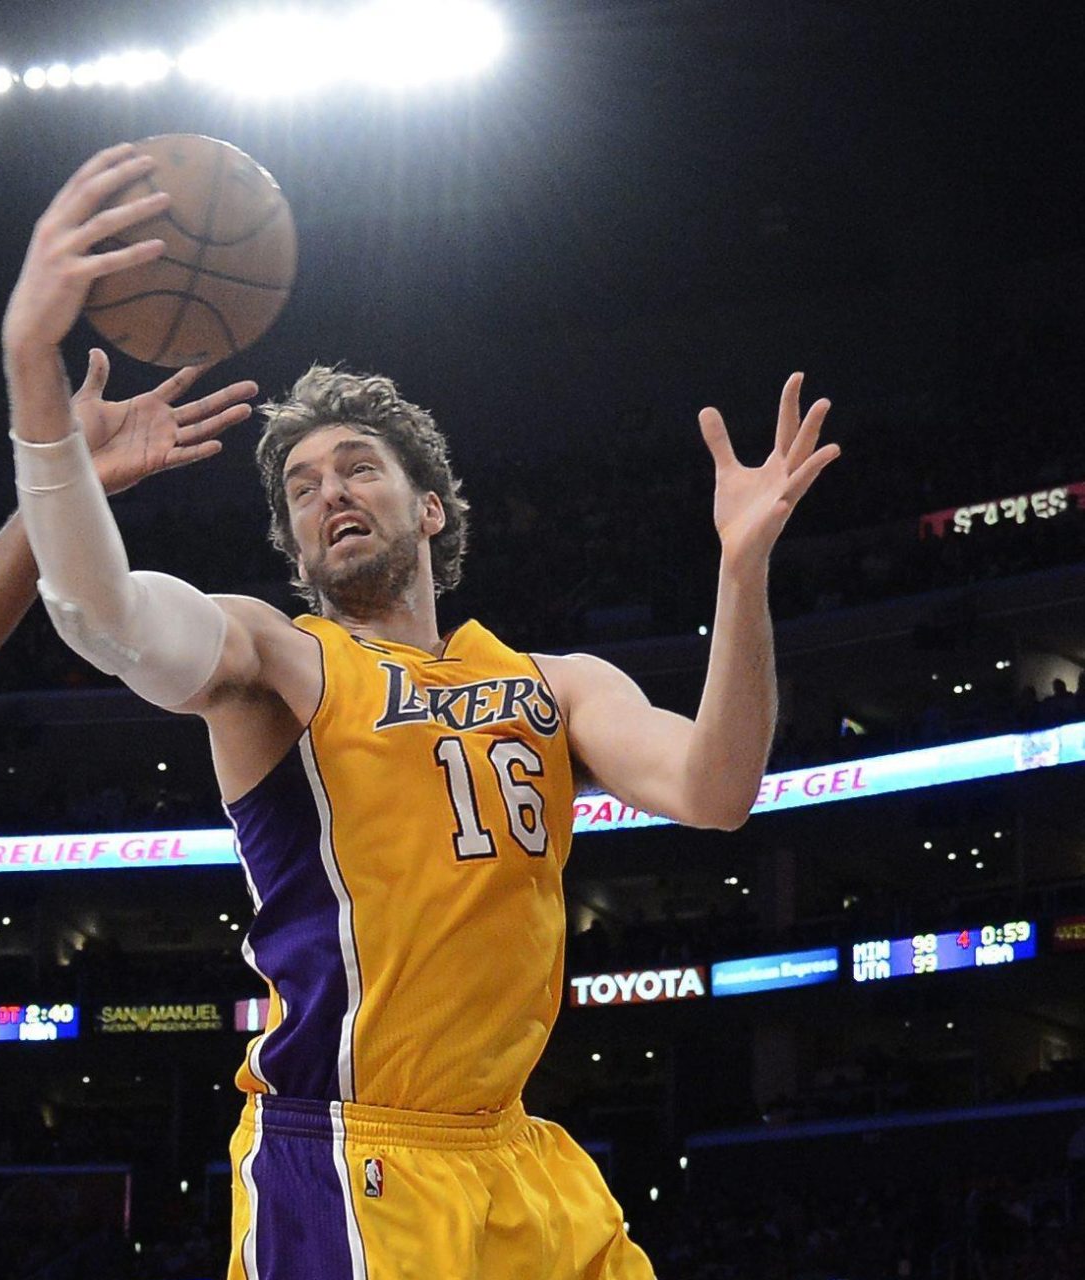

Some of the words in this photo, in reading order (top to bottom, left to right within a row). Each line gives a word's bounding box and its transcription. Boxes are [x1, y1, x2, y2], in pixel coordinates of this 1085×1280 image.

[803, 767, 867, 797] GEL
[433, 736, 548, 861] 16
[119, 838, 189, 861] GEL
[956, 930, 969, 948] 4
[981, 921, 1030, 945] 0:59
[571, 968, 705, 1005] TOYOTA
[25, 1004, 74, 1024] 2:40
[101, 1005, 136, 1023] SAN
[148, 1003, 222, 1021] MANUEL
